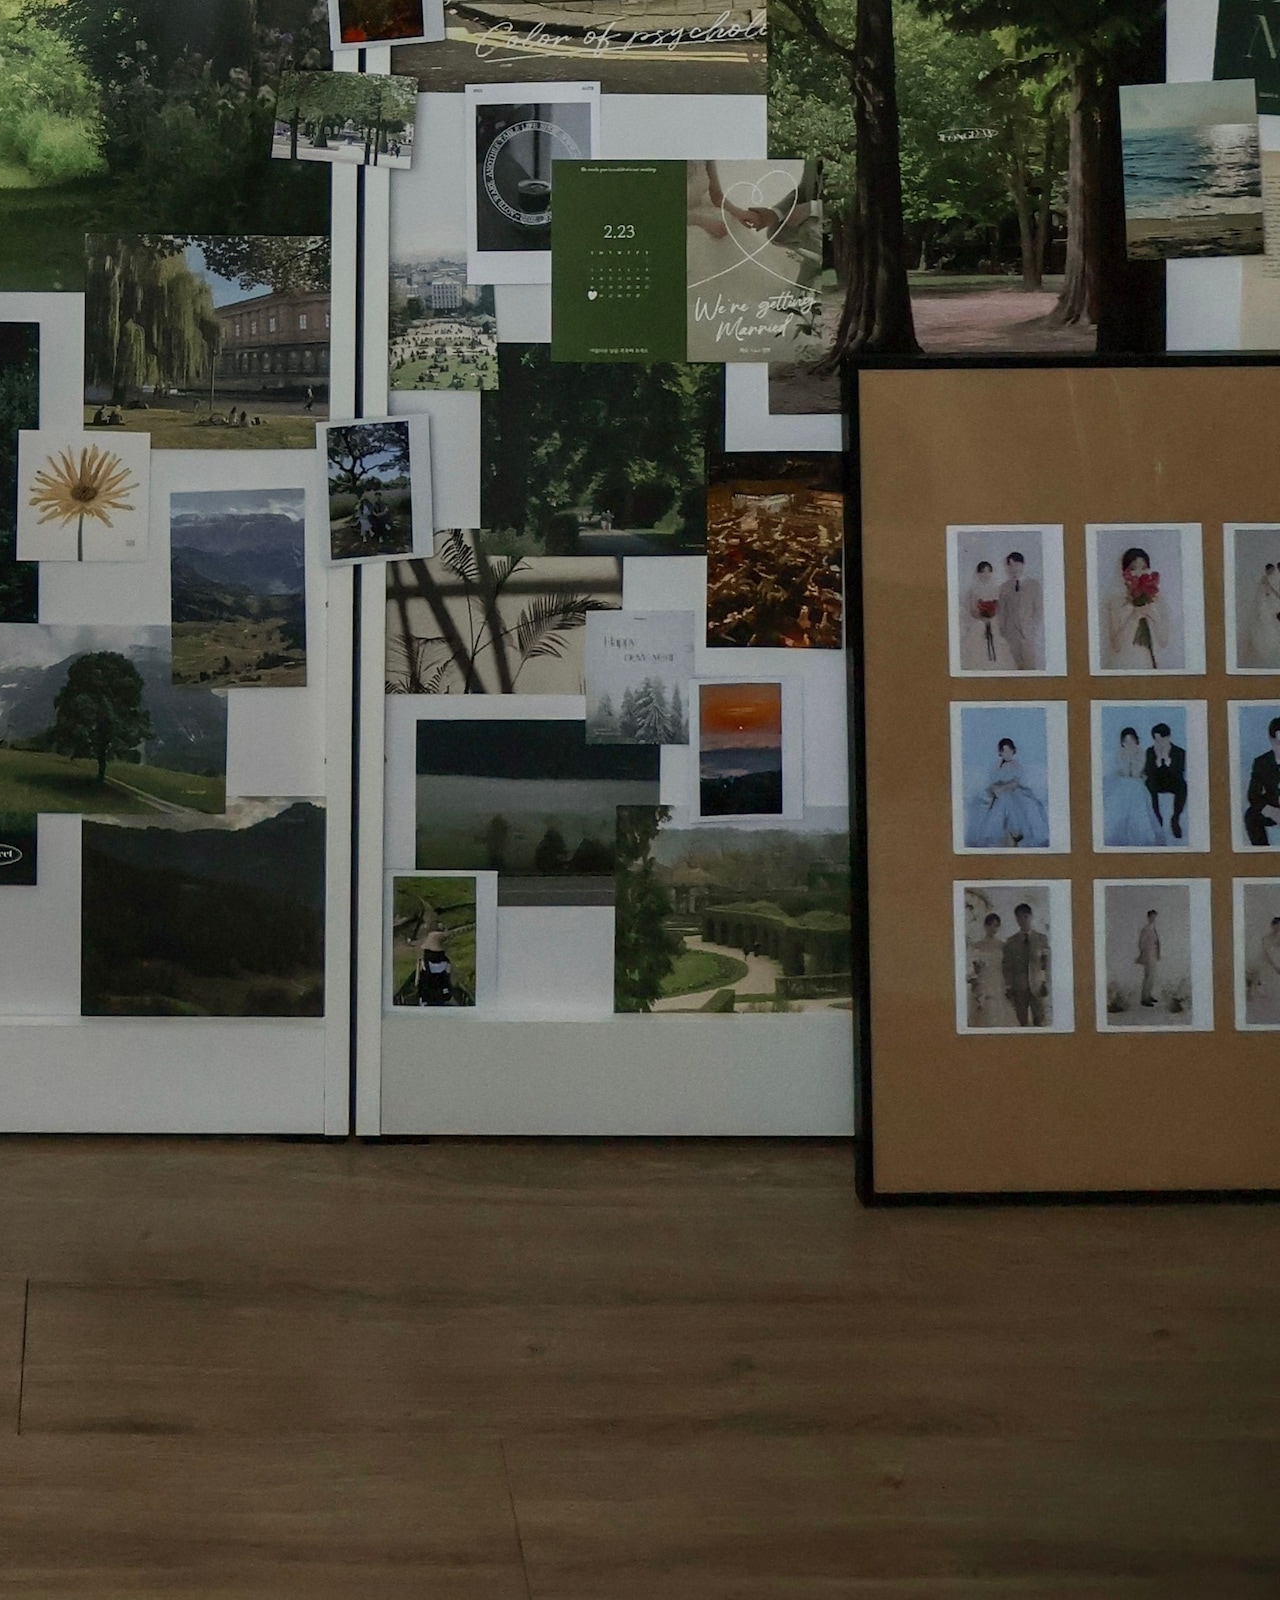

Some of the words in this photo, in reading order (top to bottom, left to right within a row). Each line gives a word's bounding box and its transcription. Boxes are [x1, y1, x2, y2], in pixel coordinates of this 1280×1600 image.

[475, 21, 575, 62] Color
[582, 17, 625, 57] of
[603, 224, 636, 239] 2.23
[757, 290, 817, 319] getting
[714, 313, 795, 343] Married
